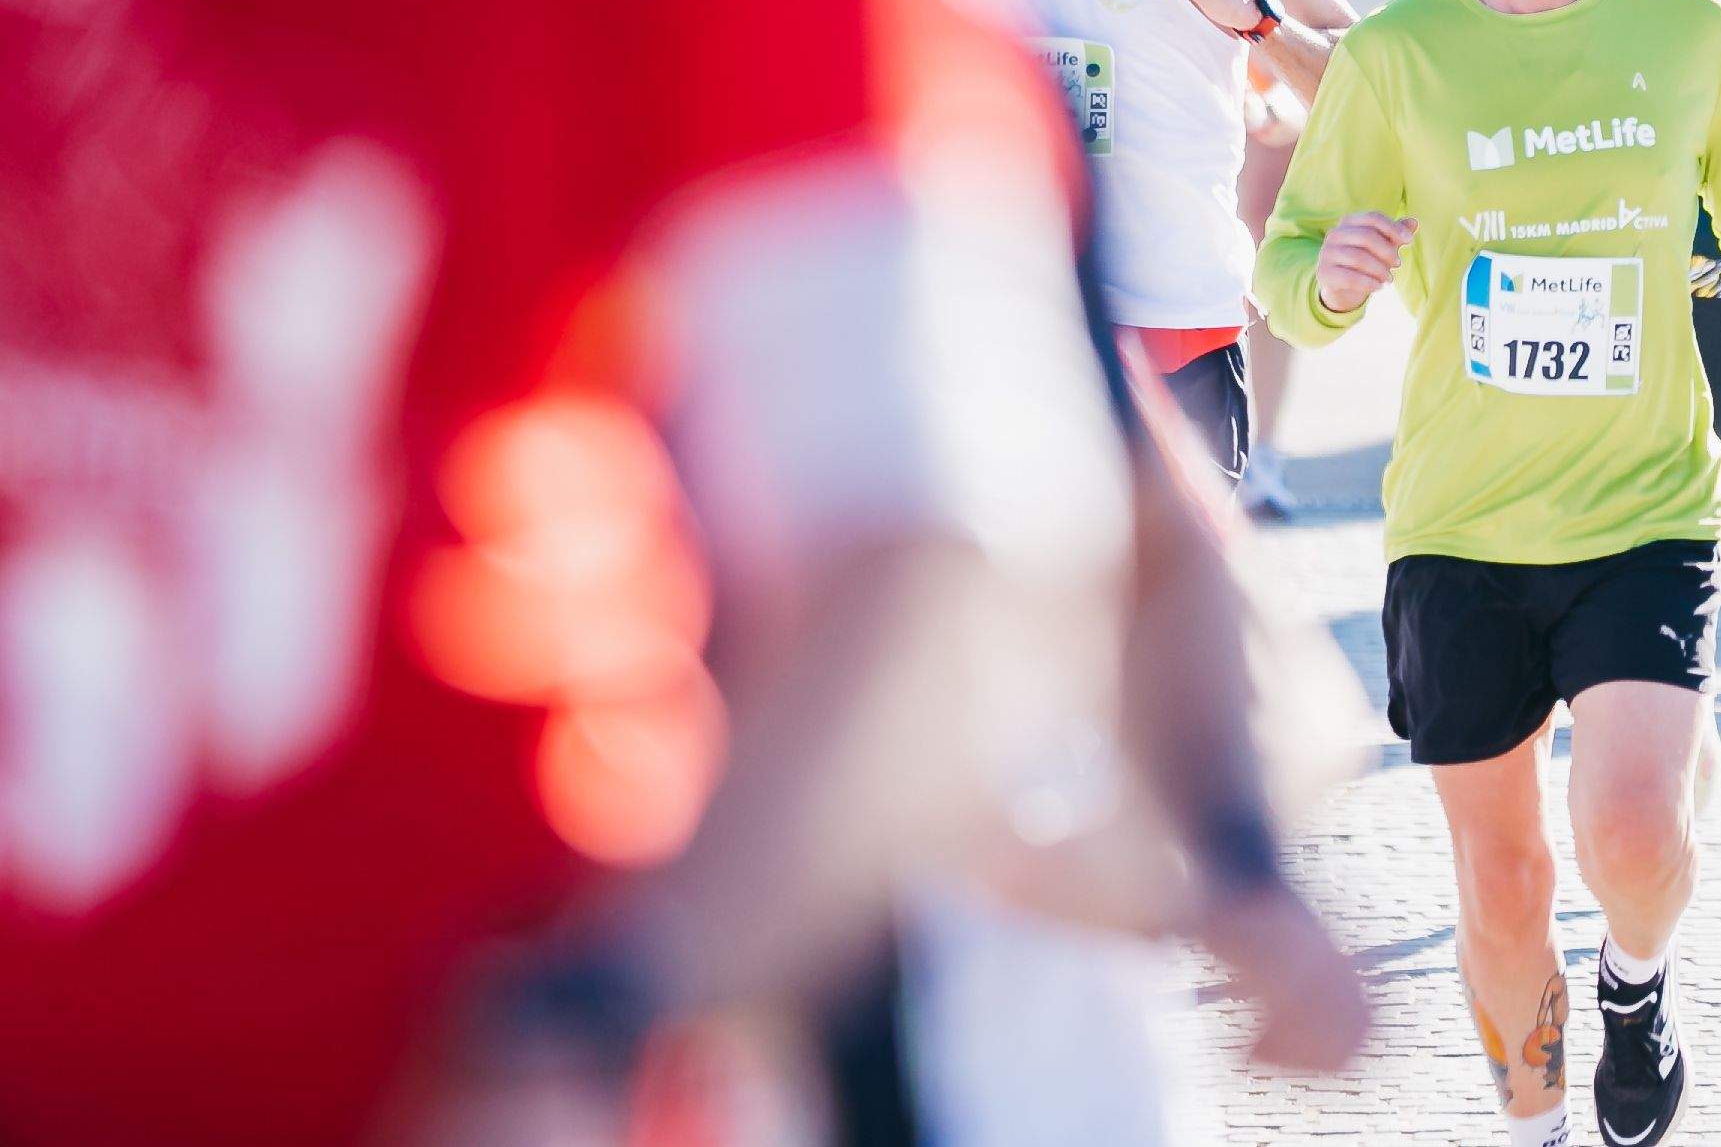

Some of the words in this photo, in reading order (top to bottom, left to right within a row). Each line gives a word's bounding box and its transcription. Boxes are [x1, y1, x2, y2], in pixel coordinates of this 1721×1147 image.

[1039, 51, 1079, 66] Life
[1524, 117, 1656, 158] MetLife
[1458, 210, 1506, 243] VIII
[1510, 223, 1551, 240] 15KM
[1556, 217, 1618, 237] MADRID
[1531, 277, 1603, 293] MetLife
[1503, 339, 1590, 380] 1732
